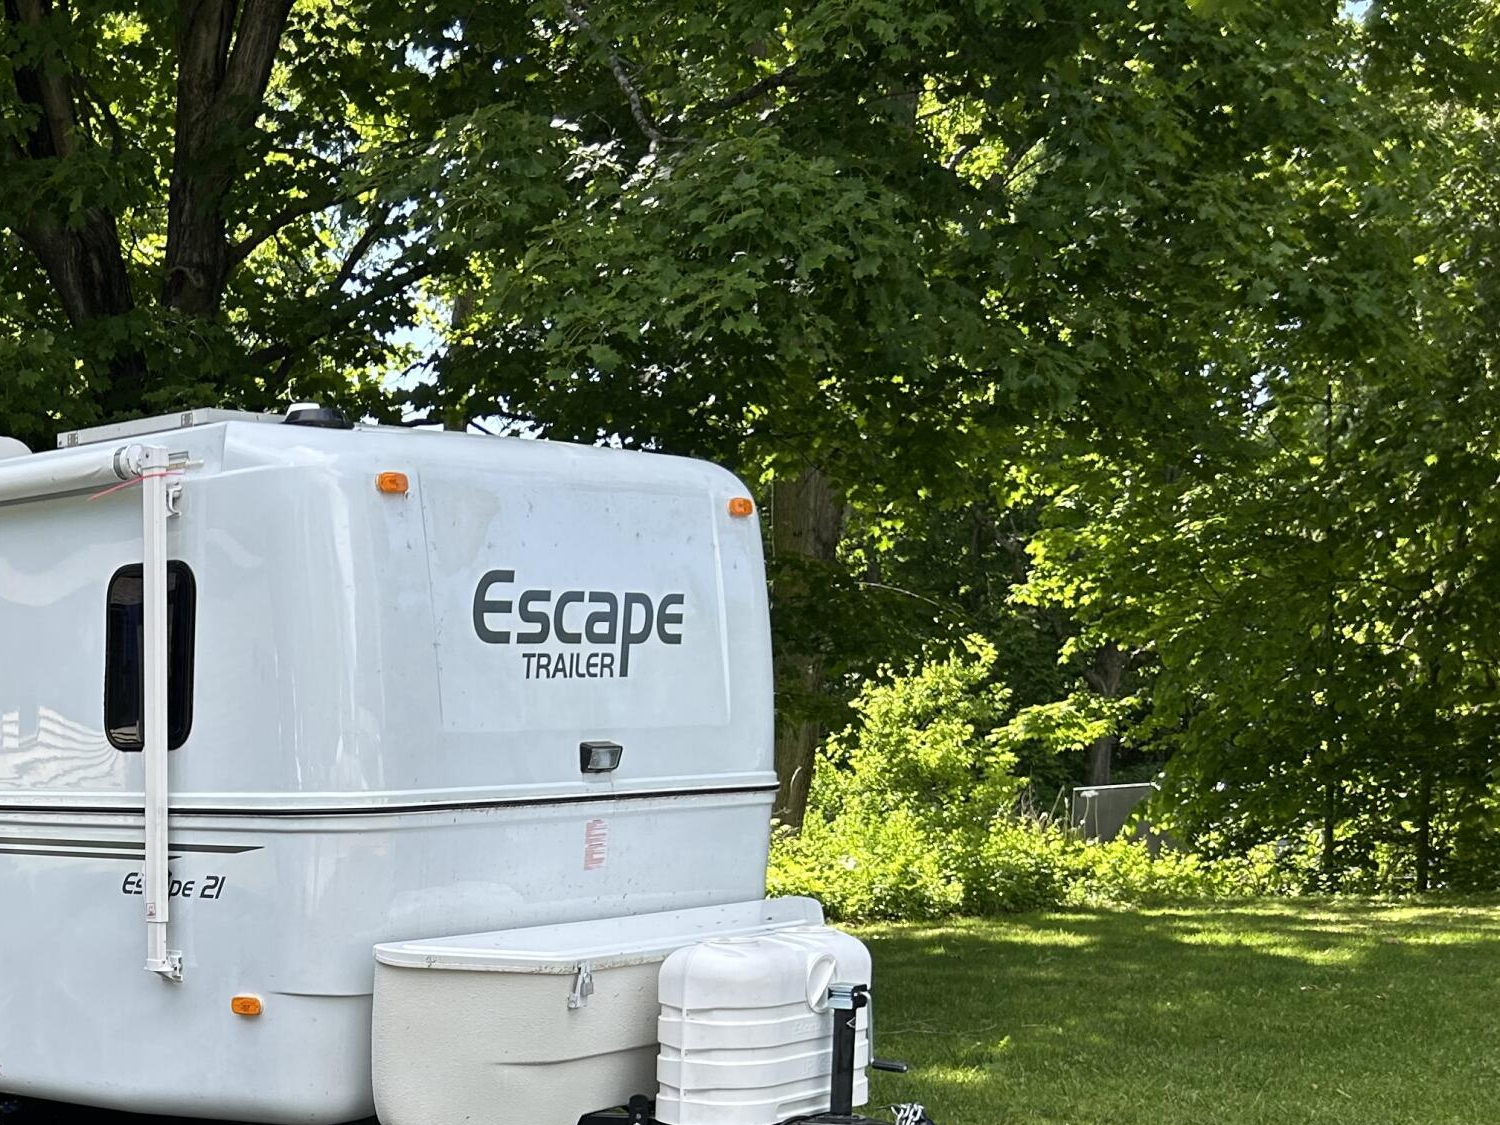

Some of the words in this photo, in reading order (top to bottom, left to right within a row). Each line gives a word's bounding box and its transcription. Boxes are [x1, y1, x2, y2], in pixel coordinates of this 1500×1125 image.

[472, 569, 685, 677] Escape
[522, 653, 614, 679] TRAILER
[199, 875, 226, 899] 21
